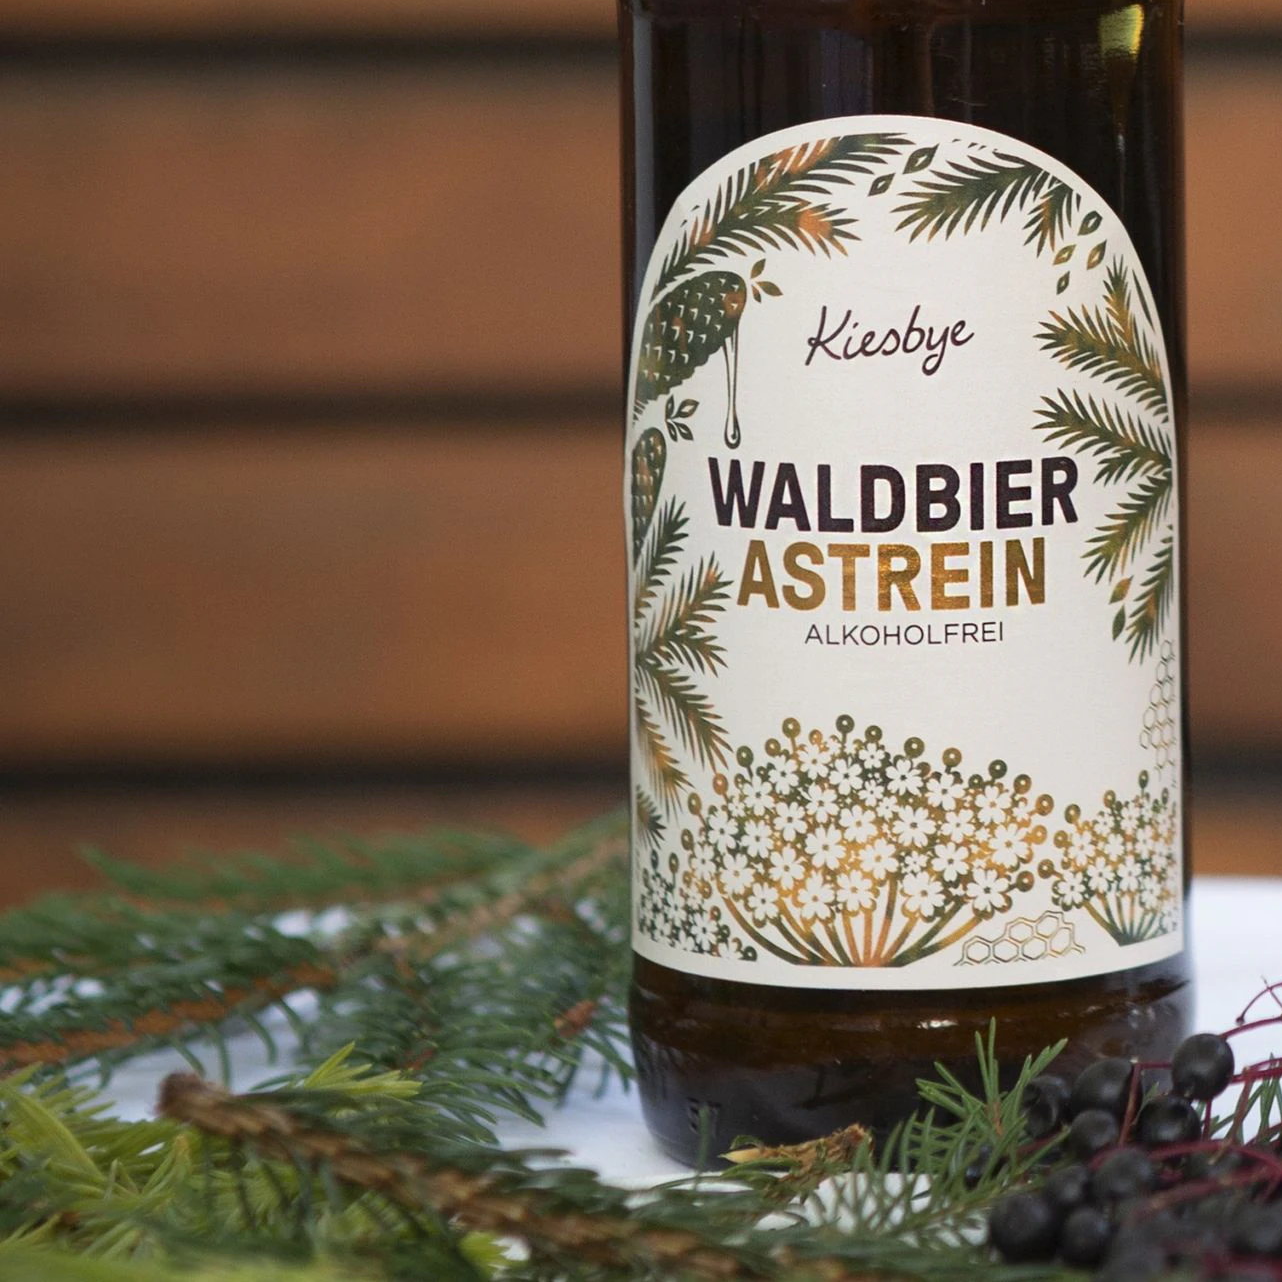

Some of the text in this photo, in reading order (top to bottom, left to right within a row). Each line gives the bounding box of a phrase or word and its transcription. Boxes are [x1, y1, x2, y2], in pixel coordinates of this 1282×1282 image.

[804, 305, 974, 376] Kiesbye
[707, 456, 1079, 533] WALDBIER
[736, 536, 1046, 611] ASTREIN
[804, 621, 1004, 647] ALKOHOLFREI
